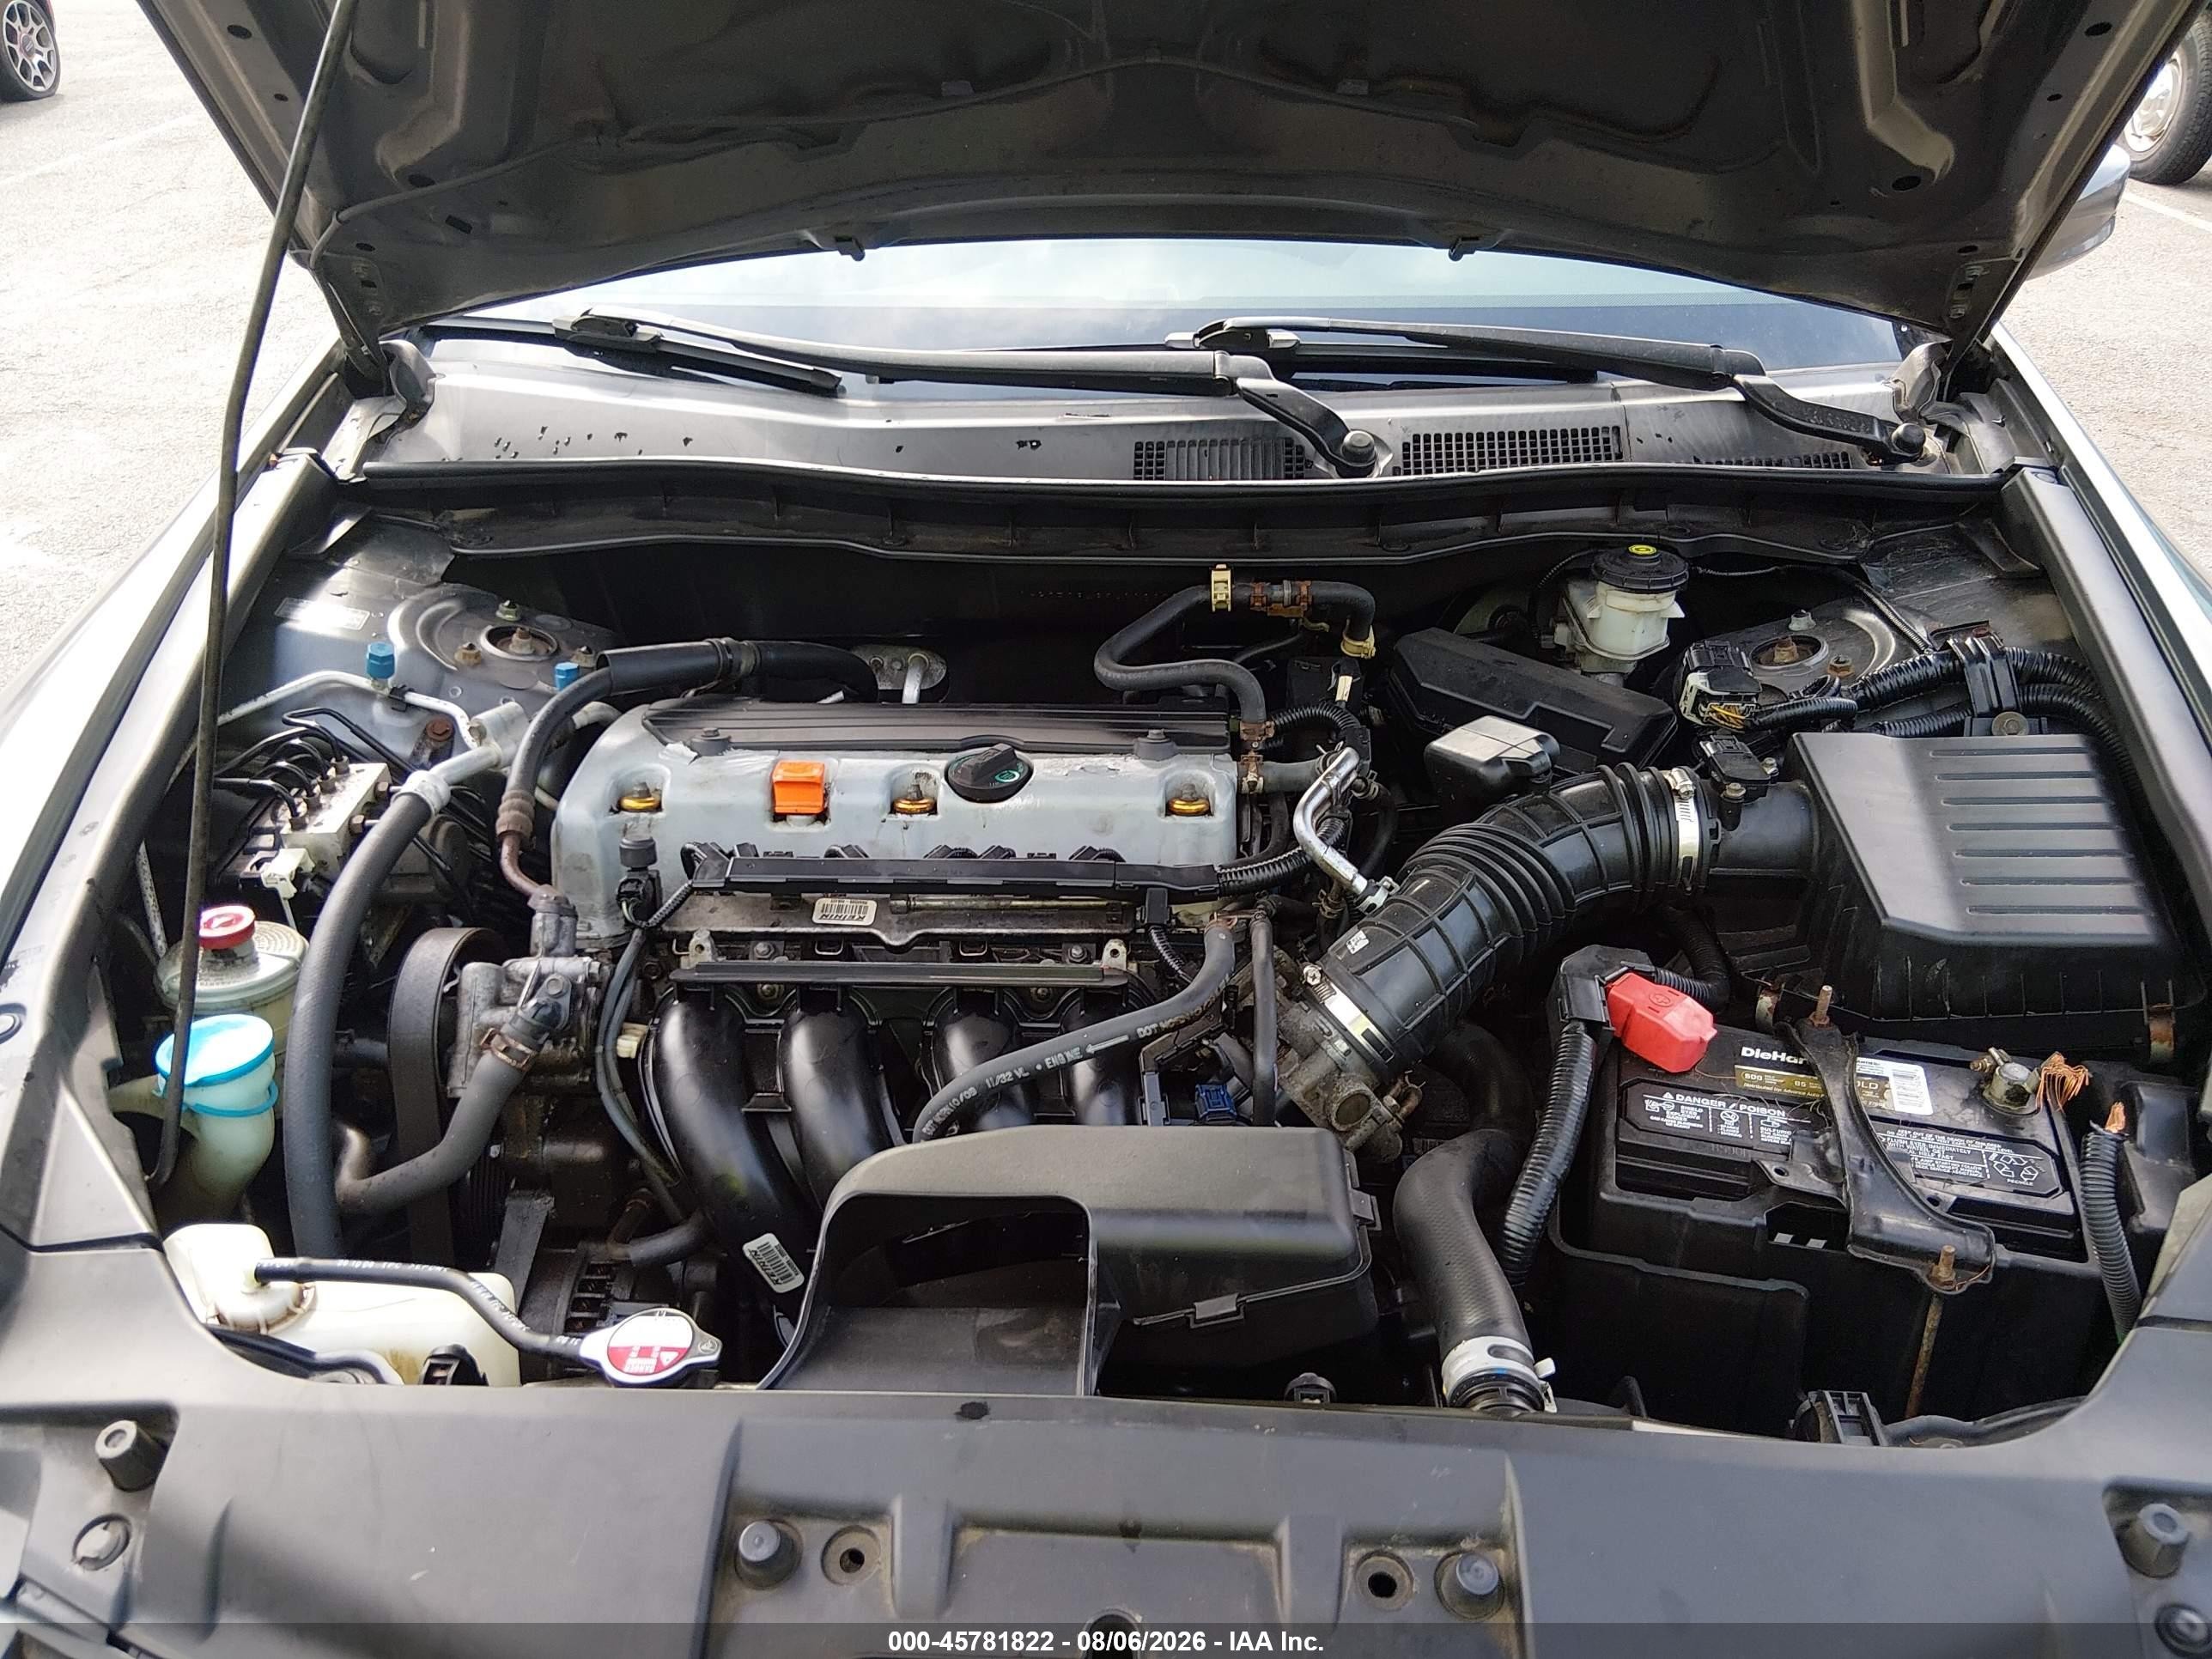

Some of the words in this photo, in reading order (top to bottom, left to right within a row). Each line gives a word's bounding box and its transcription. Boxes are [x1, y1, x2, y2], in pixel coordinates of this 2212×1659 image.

[985, 1070, 1013, 1089] 11/32
[1044, 1046, 1084, 1070] ENGINE
[1136, 1023, 1158, 1038] DOT
[1741, 1046, 1806, 1066] DieHar
[1675, 1093, 1726, 1109] DANGER
[1739, 1103, 1786, 1116] POISON
[1665, 1110, 1700, 1121] EXPLOSIVE
[1759, 1126, 1791, 1134] SULFURIC
[1887, 1136, 1908, 1145] FLUSH
[1928, 1142, 1971, 1154] IMMEDIATELY
